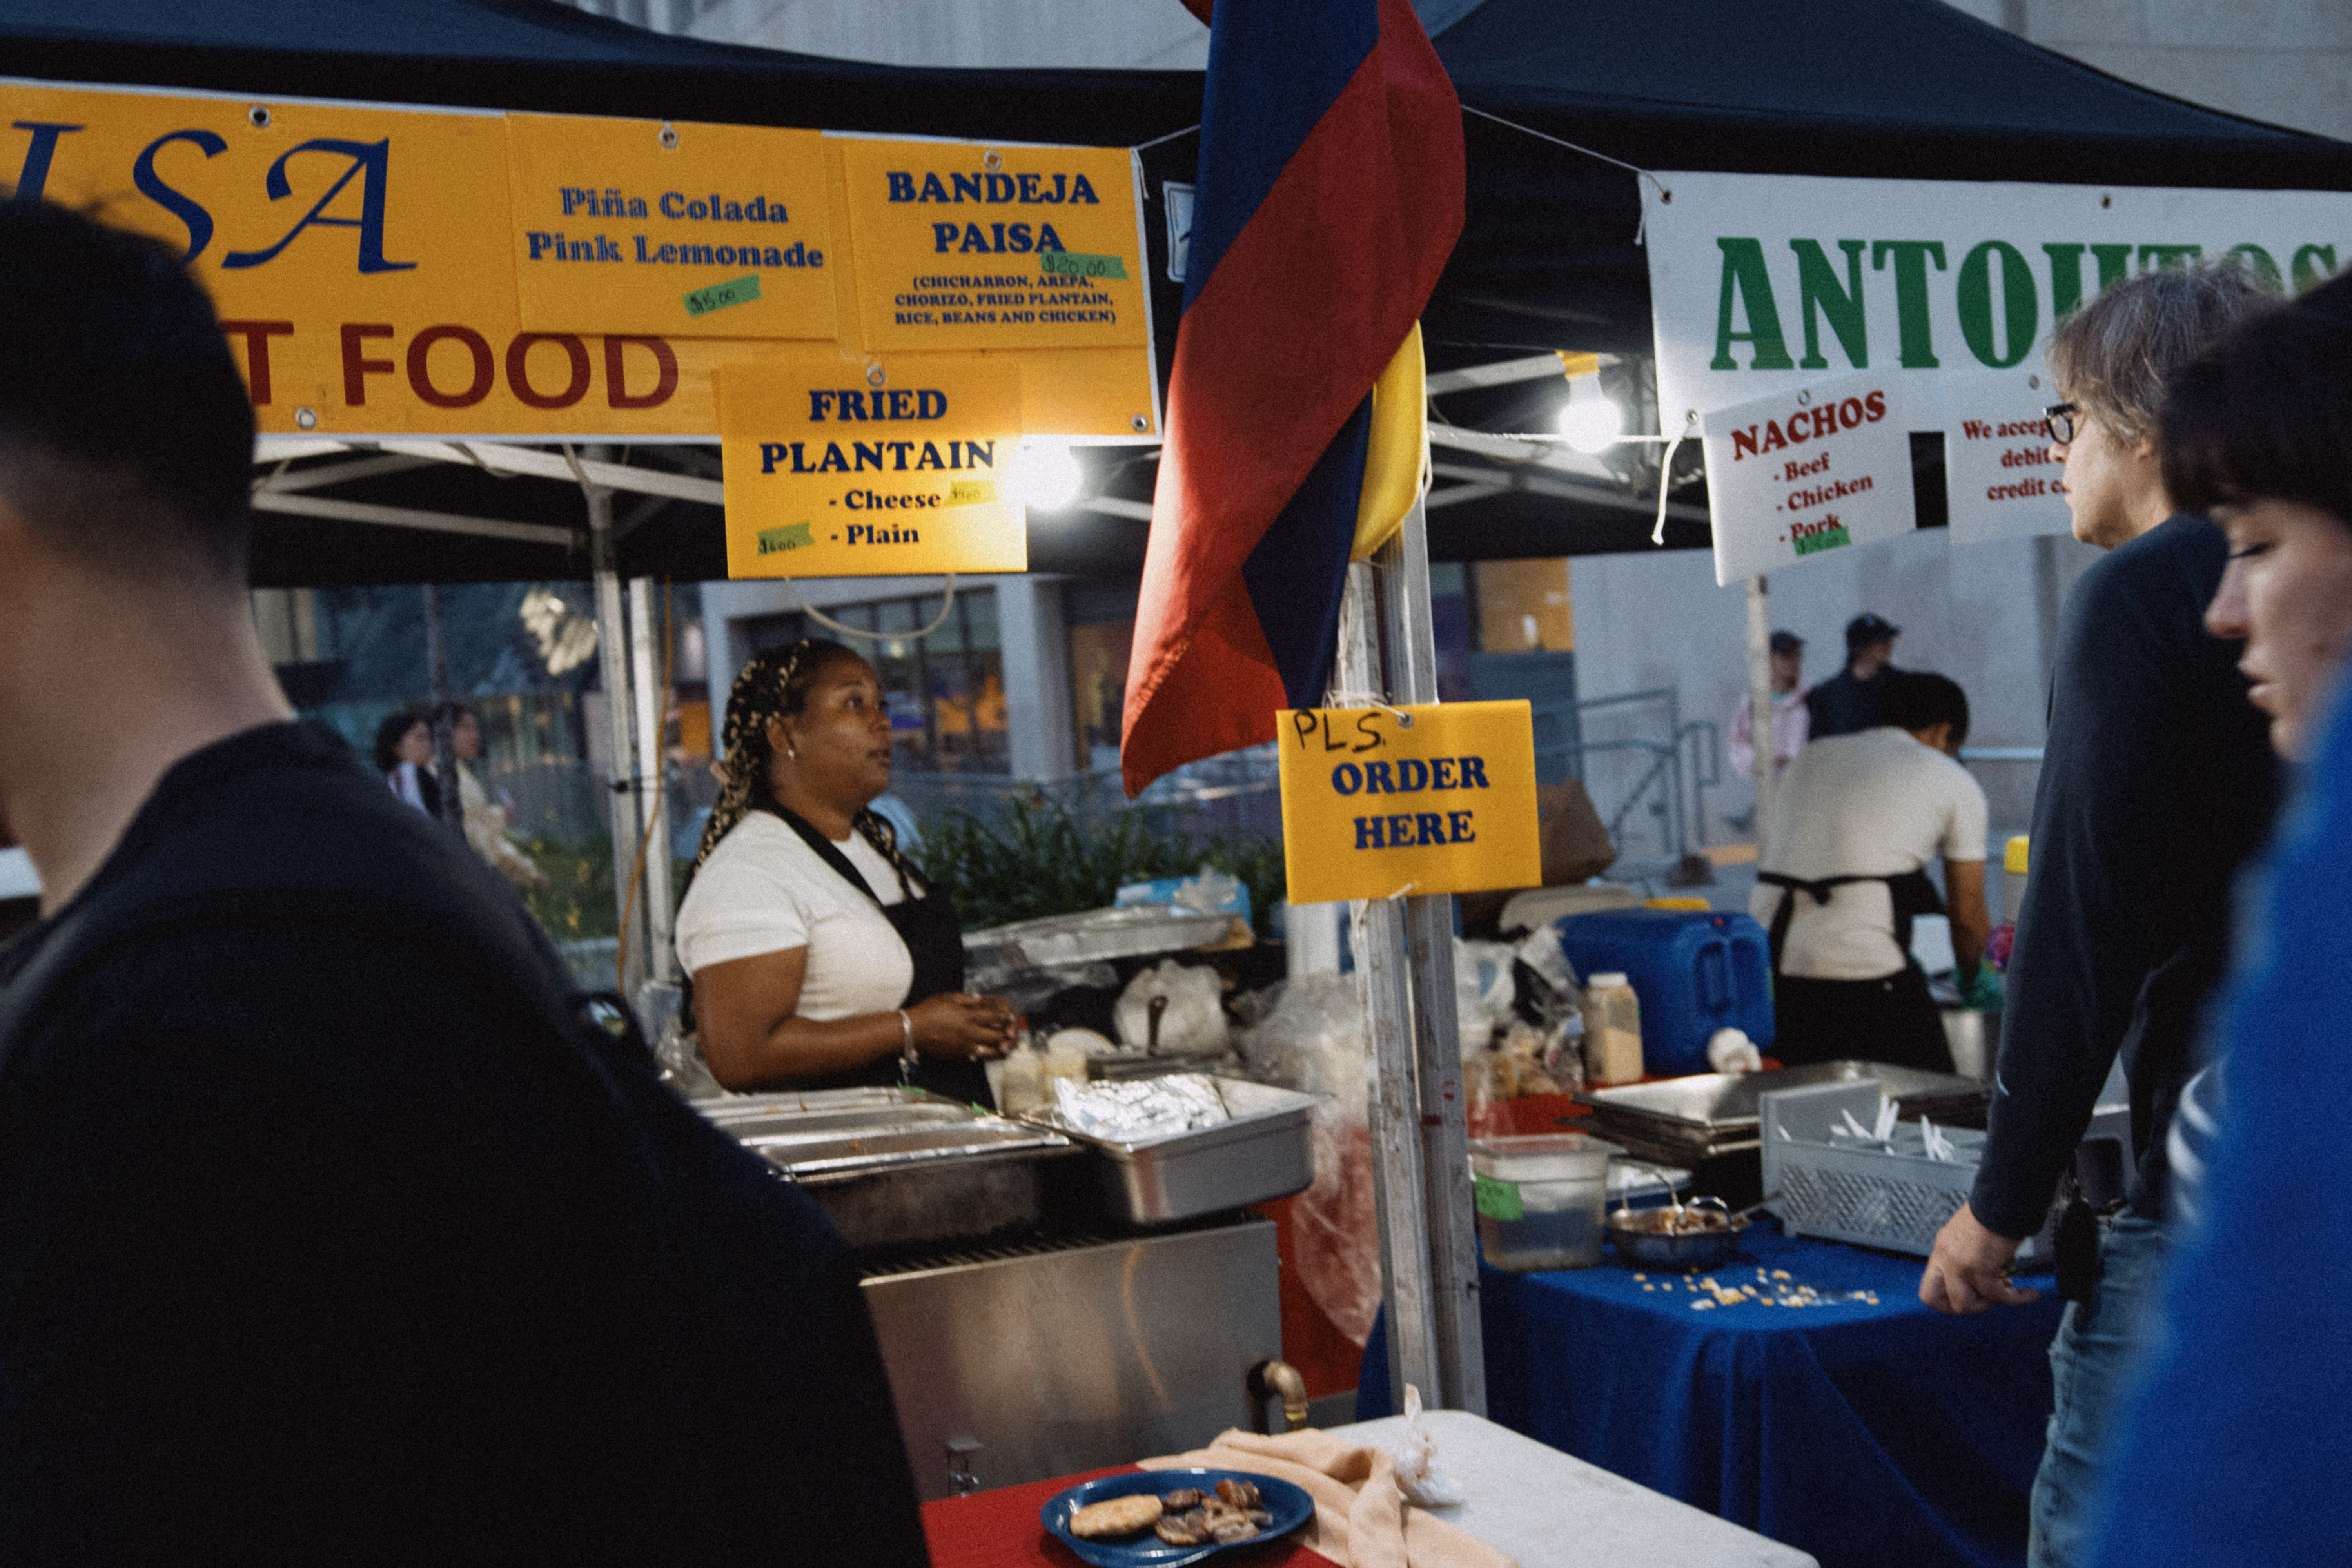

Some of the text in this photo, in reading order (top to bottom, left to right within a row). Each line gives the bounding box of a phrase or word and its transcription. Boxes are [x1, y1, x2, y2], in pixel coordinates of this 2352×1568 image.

[886, 171, 1100, 204] BANDEJA
[559, 187, 789, 223] Piña Colada
[526, 232, 824, 268] Pink Lemonade
[931, 222, 1067, 254] PAISA
[913, 274, 1094, 290] (CHICHARRON, AREPA,
[894, 292, 1114, 307] CHORIZO, FRIED PLANTAIN,
[895, 310, 1117, 326] RICE, BEANS AND CHICKEN)
[339, 322, 679, 410] FOOD
[808, 389, 948, 422] FRIED
[1731, 390, 1887, 462] NACHOS
[1962, 419, 2049, 440] We accep
[759, 440, 995, 474] PLANTAIN
[1784, 451, 1830, 483] Beef
[2001, 446, 2051, 468] debit
[844, 490, 942, 510] Cheese
[1786, 474, 1874, 512] Chicken
[1987, 478, 2046, 501] credit
[846, 524, 920, 545] Plain
[1790, 514, 1843, 542] Pork
[1331, 756, 1490, 796] ORDER
[1353, 810, 1476, 850] HERE
